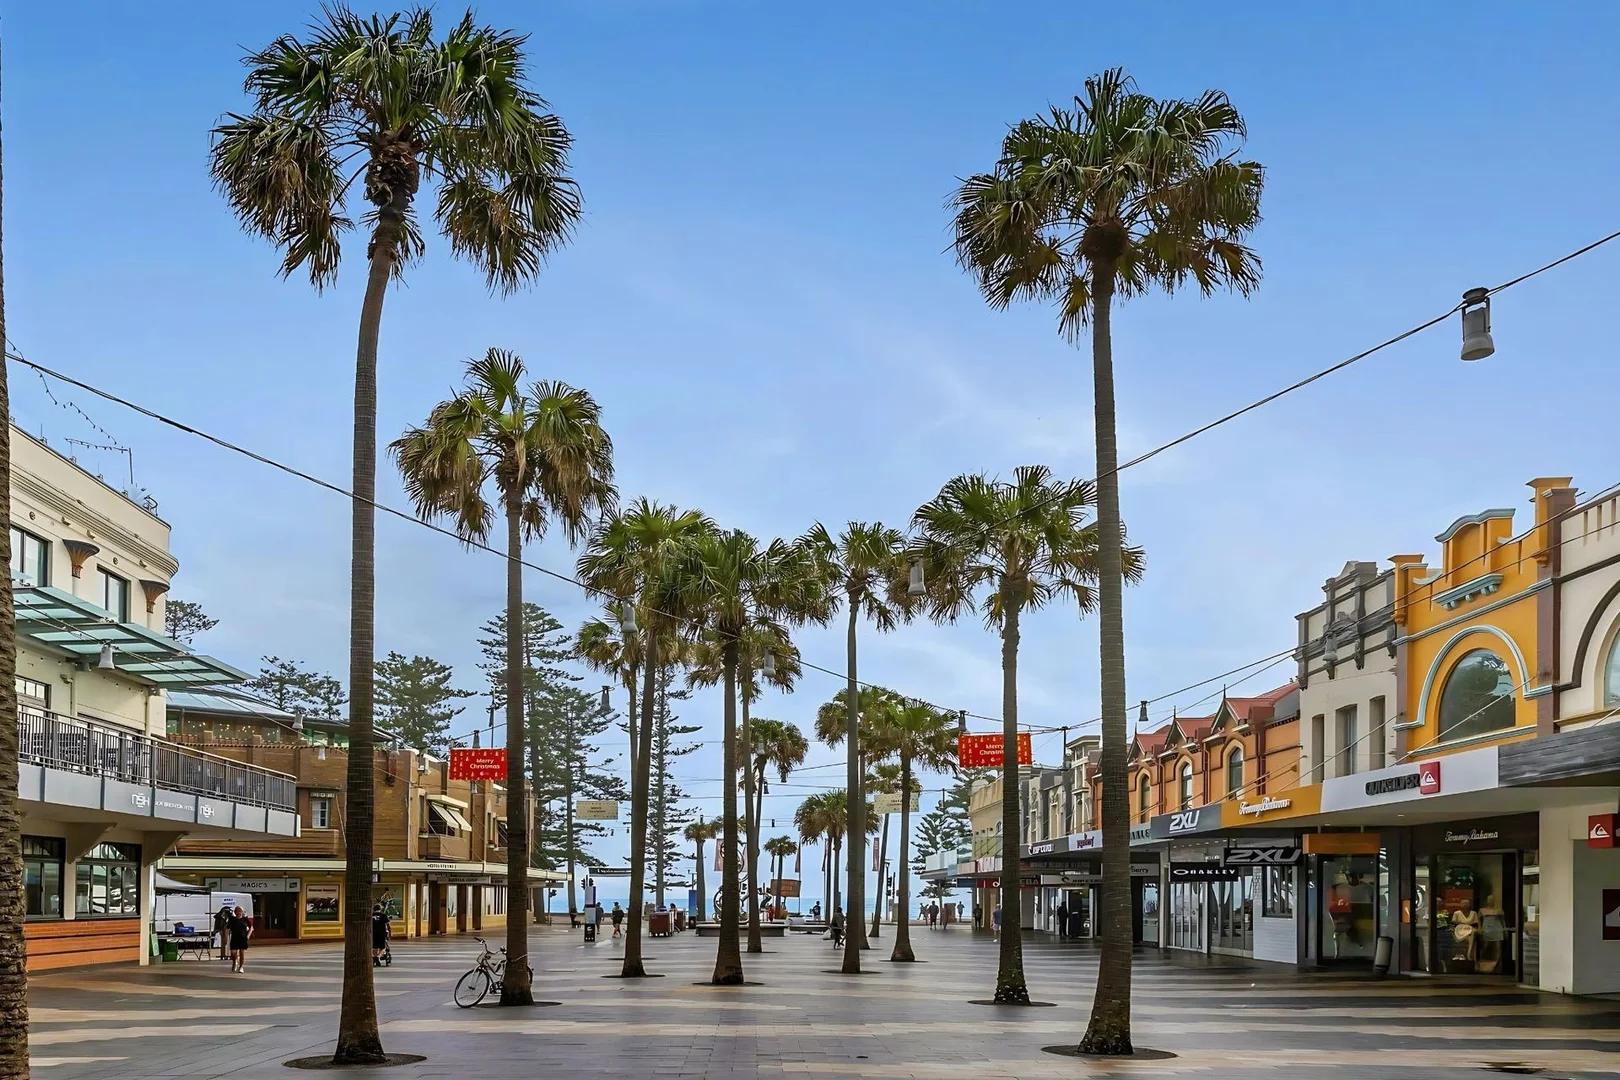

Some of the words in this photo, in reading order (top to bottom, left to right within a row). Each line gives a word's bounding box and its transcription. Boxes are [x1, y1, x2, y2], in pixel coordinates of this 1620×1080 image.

[1365, 773, 1420, 796] QUIKSILVER
[1239, 801, 1262, 817] Tommy
[1261, 797, 1291, 812] Bahama
[1169, 810, 1200, 831] 2XU
[1445, 830, 1470, 845] Tommy
[1470, 829, 1498, 840] Bahama
[1226, 849, 1301, 863] 2XU
